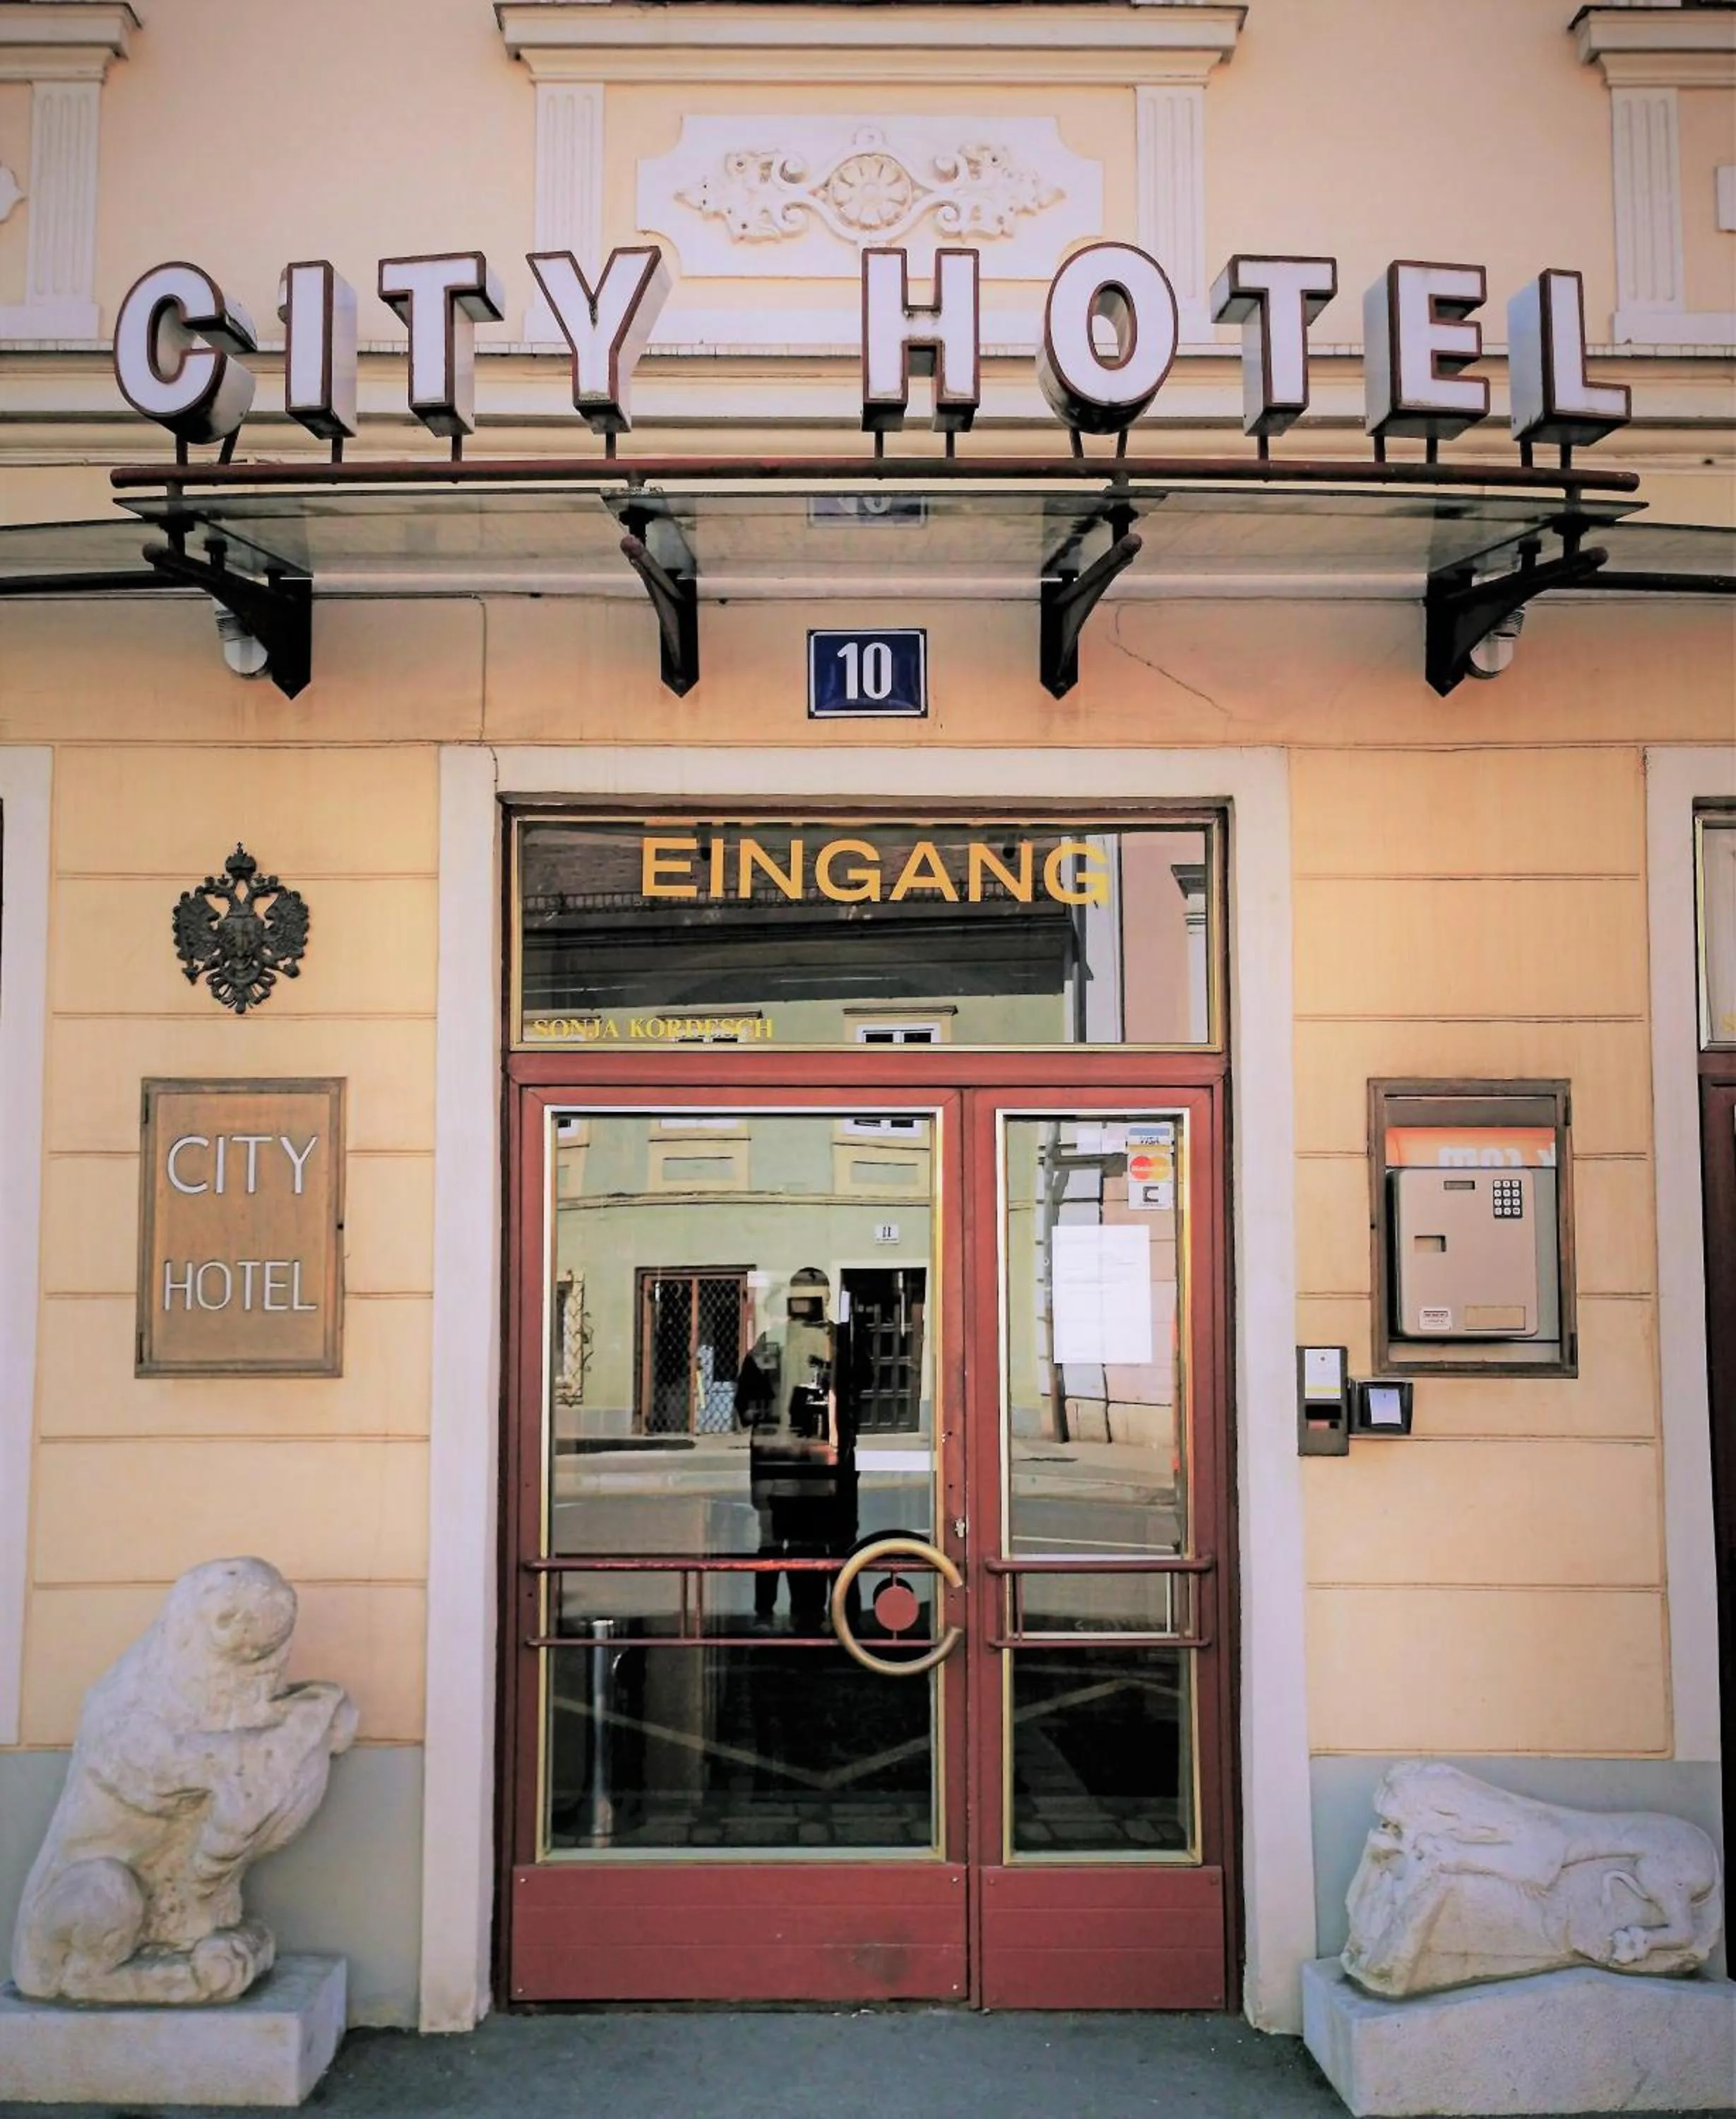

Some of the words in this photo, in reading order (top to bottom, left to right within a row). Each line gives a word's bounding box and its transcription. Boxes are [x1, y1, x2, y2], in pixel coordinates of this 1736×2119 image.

[114, 245, 664, 418] CITY
[861, 241, 1632, 423] HOTEL
[838, 643, 892, 700] 10
[642, 837, 1108, 905] EINGANG
[532, 1019, 619, 1039] SONJA
[630, 1018, 772, 1039] KORDESCH
[167, 1135, 317, 1194] CITY
[164, 1260, 317, 1311] HOTEL
